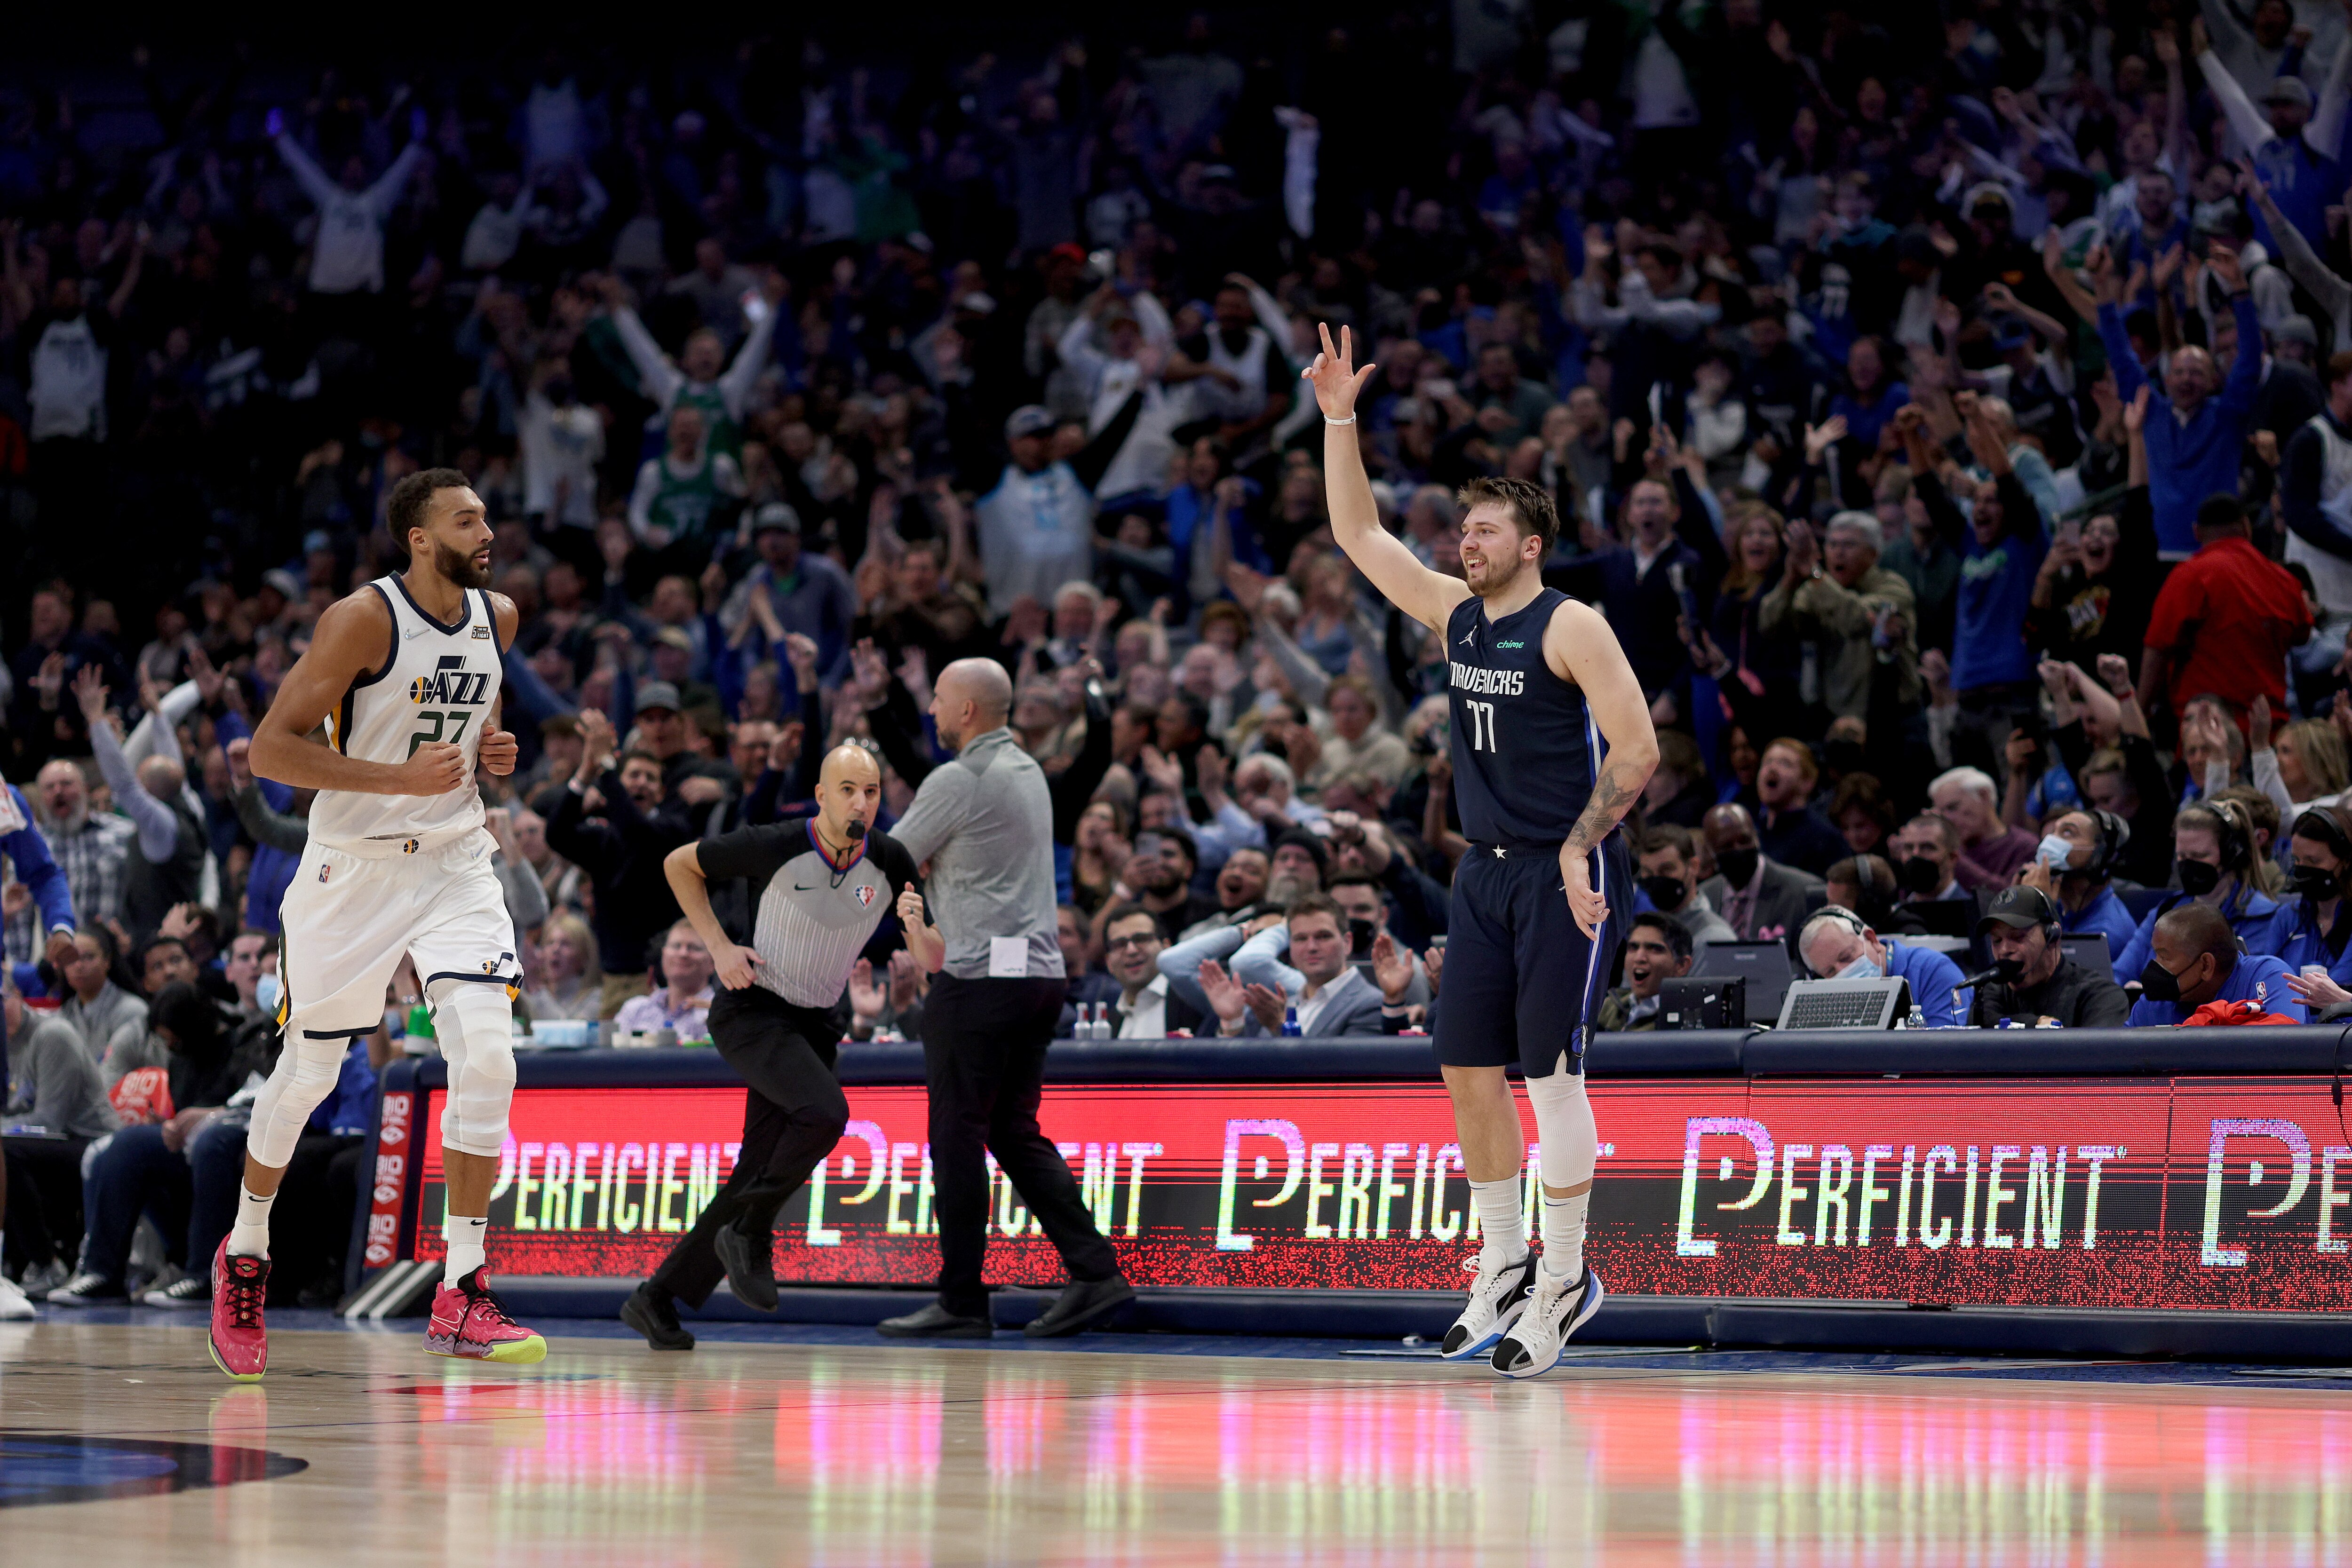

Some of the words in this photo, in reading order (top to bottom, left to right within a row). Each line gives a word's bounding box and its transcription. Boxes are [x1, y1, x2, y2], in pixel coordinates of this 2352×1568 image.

[472, 627, 477, 638] 5
[1497, 640, 1524, 649] chime
[410, 656, 491, 704] JAZZ
[1450, 661, 1524, 696] MAVERICKS
[407, 711, 472, 761] 27
[1466, 699, 1496, 753] 77
[1676, 1117, 2121, 1256] PERFICIENT
